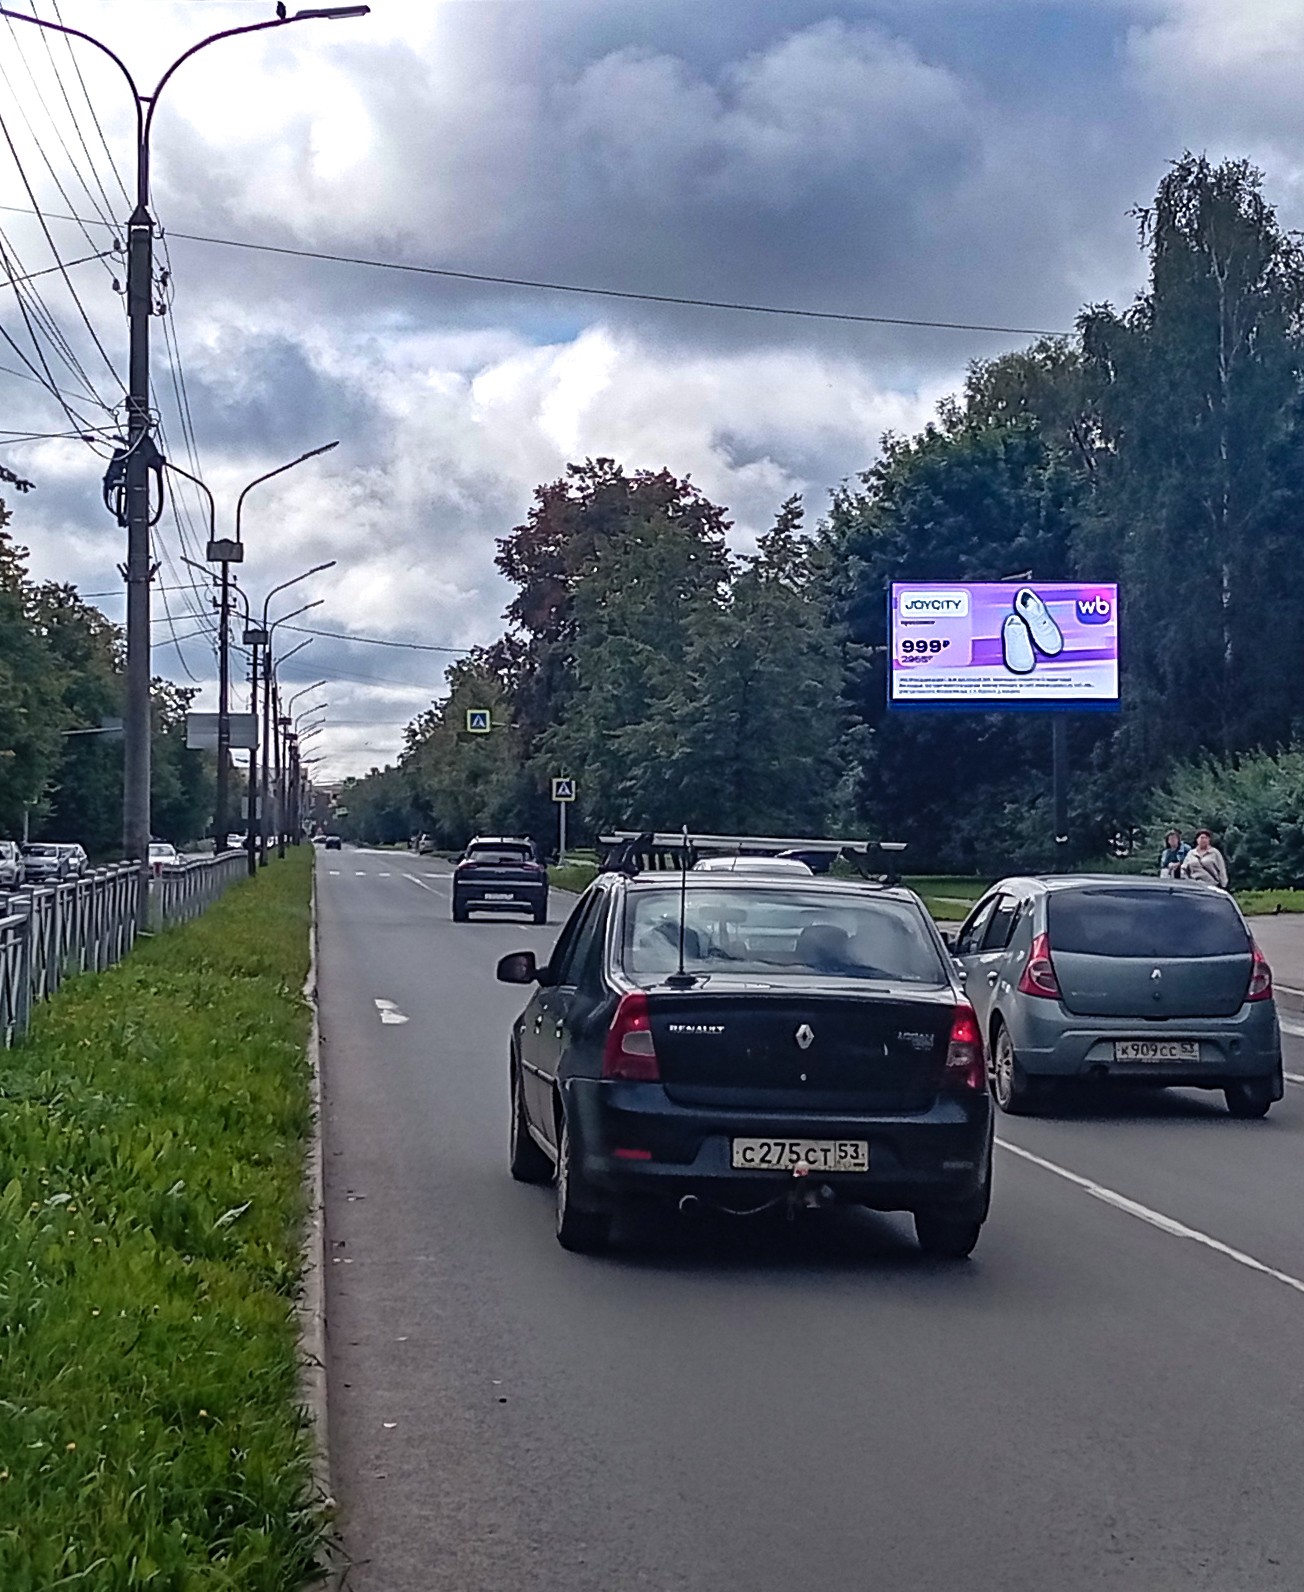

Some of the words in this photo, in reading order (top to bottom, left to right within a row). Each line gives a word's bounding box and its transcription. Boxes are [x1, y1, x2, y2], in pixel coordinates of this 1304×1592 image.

[905, 600, 961, 610] JOYCITY
[1078, 595, 1110, 614] wb
[742, 1142, 831, 1166] С275СТ
[839, 1143, 859, 1160] 53
